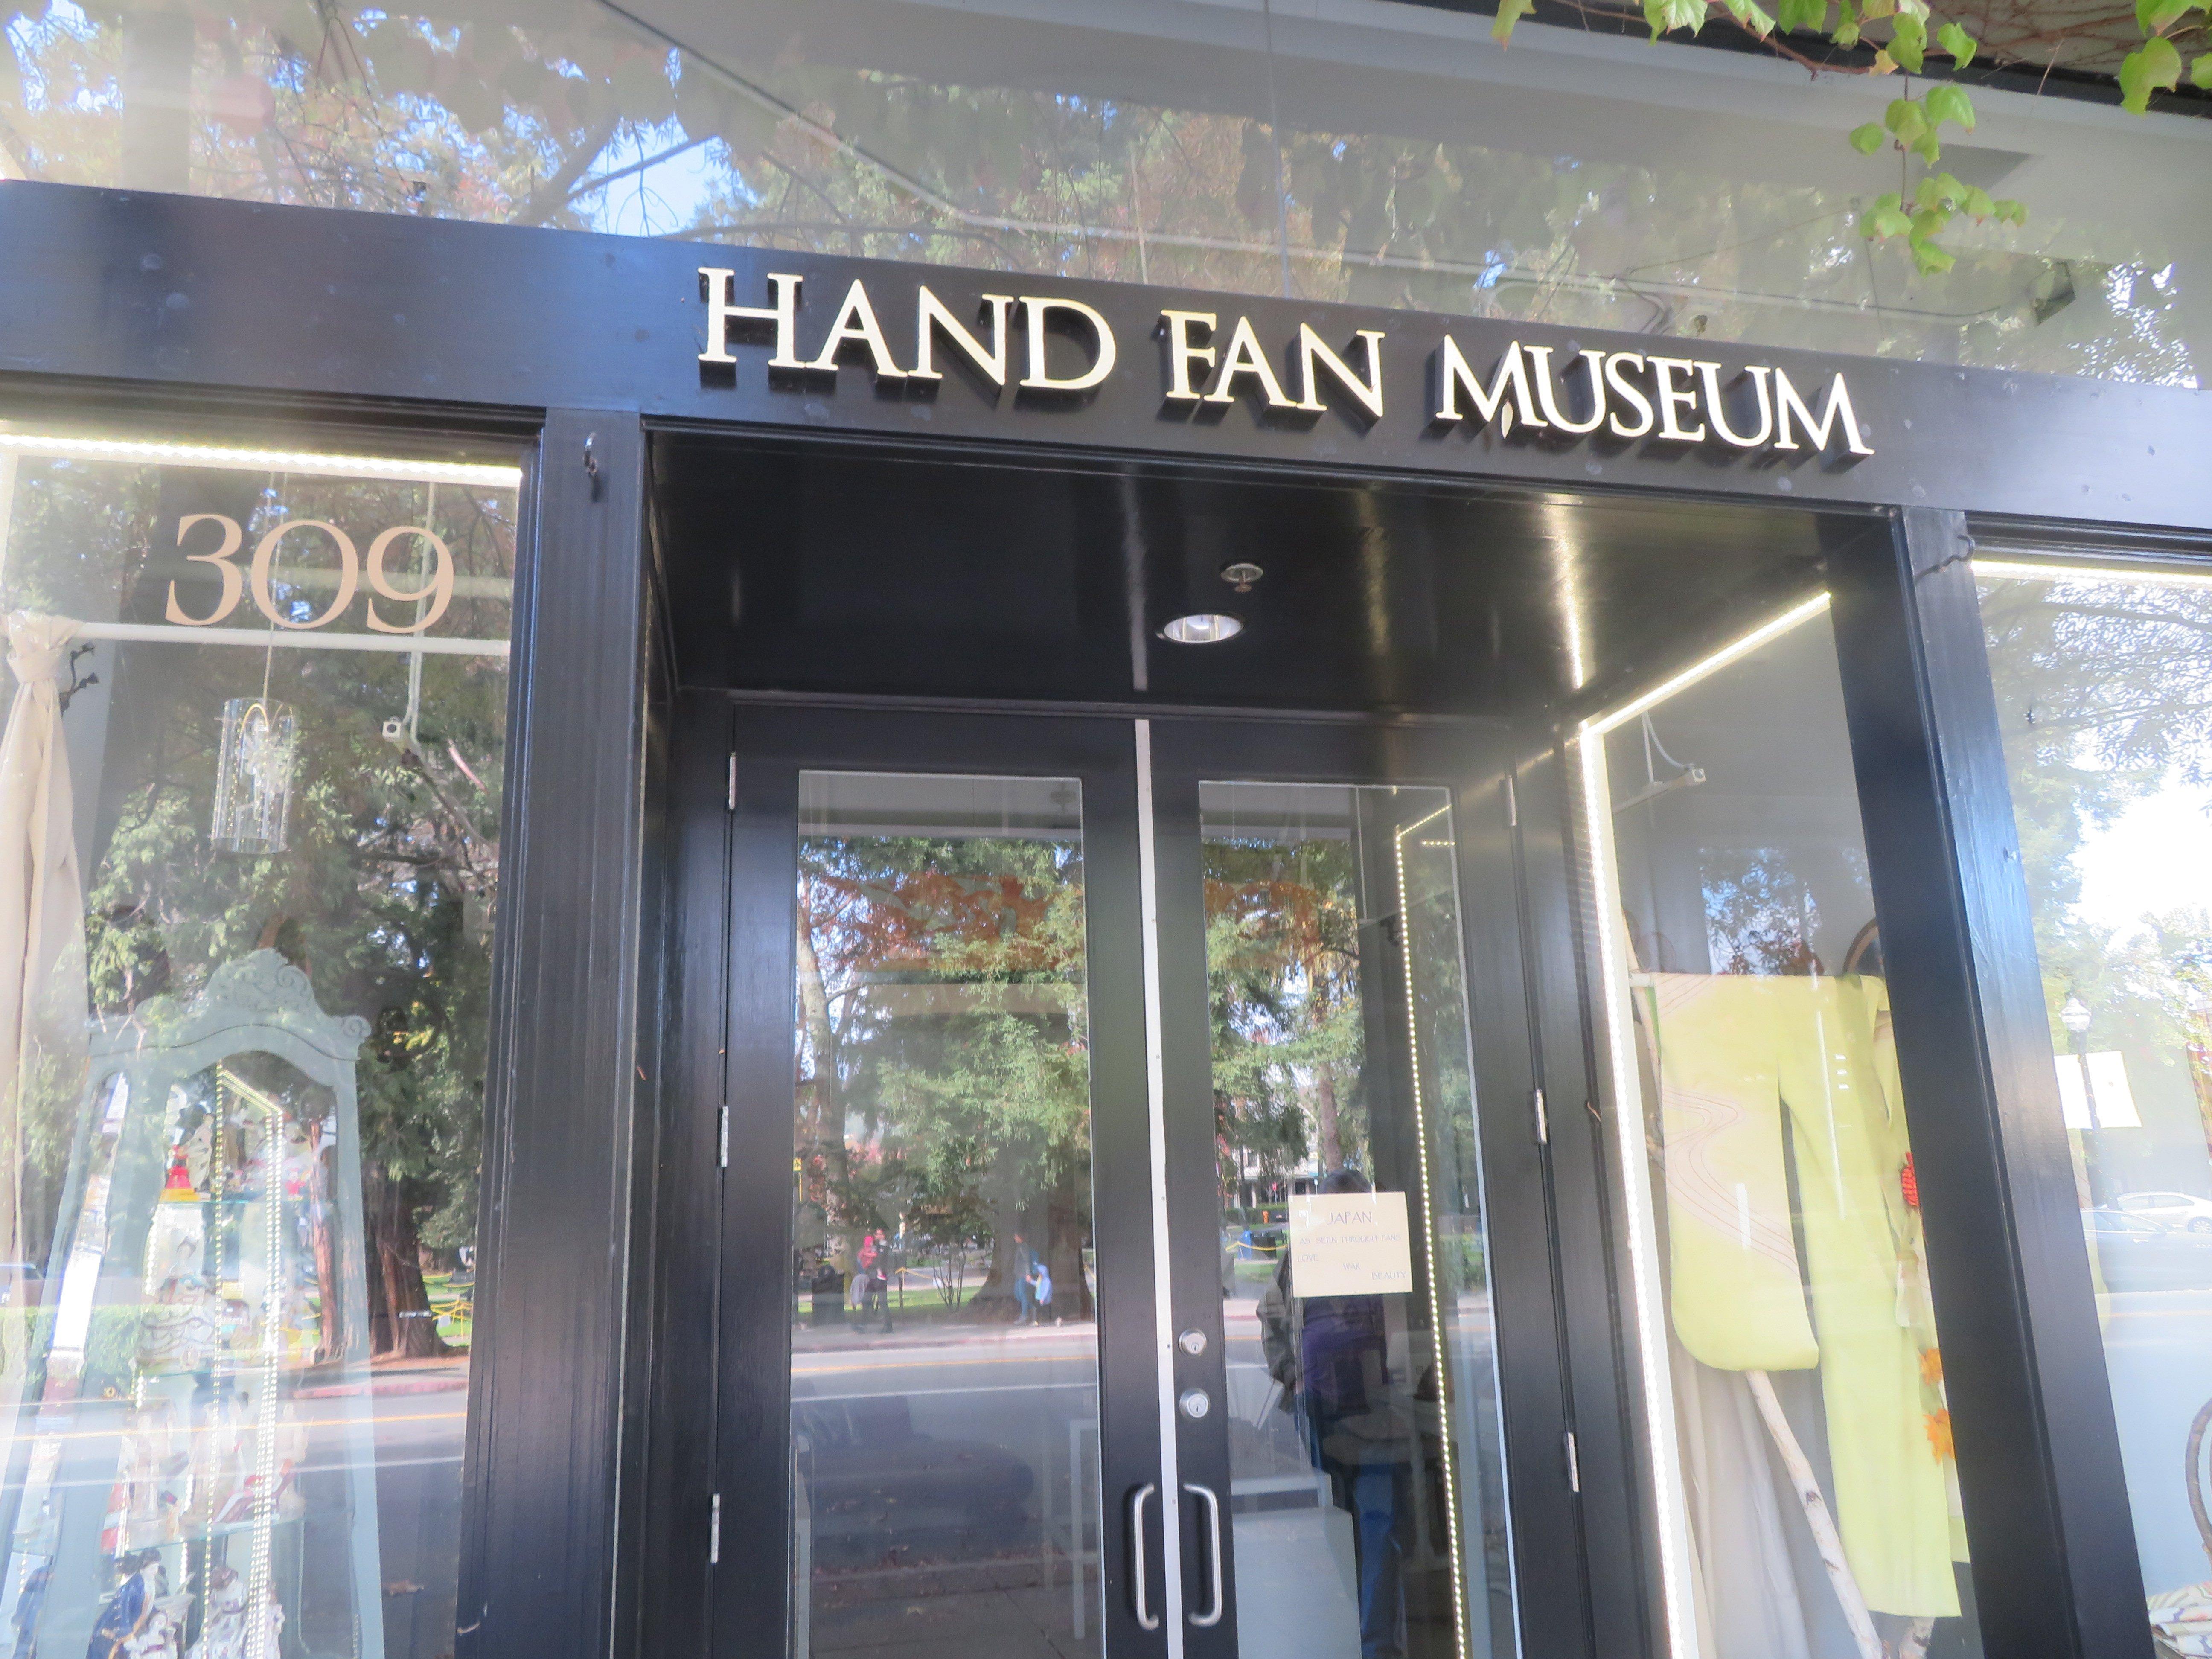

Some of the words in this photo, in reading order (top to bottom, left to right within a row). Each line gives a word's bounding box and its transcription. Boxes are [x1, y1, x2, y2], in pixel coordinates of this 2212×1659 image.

[697, 267, 1117, 390] HAND
[1160, 309, 1386, 417] FAN
[1435, 334, 1875, 455] MUSEUM
[165, 514, 454, 634] 309
[1327, 1211, 1372, 1225] JAPAN
[1341, 1235, 1378, 1243] THROUGH
[1371, 1272, 1407, 1280] BEAUTY
